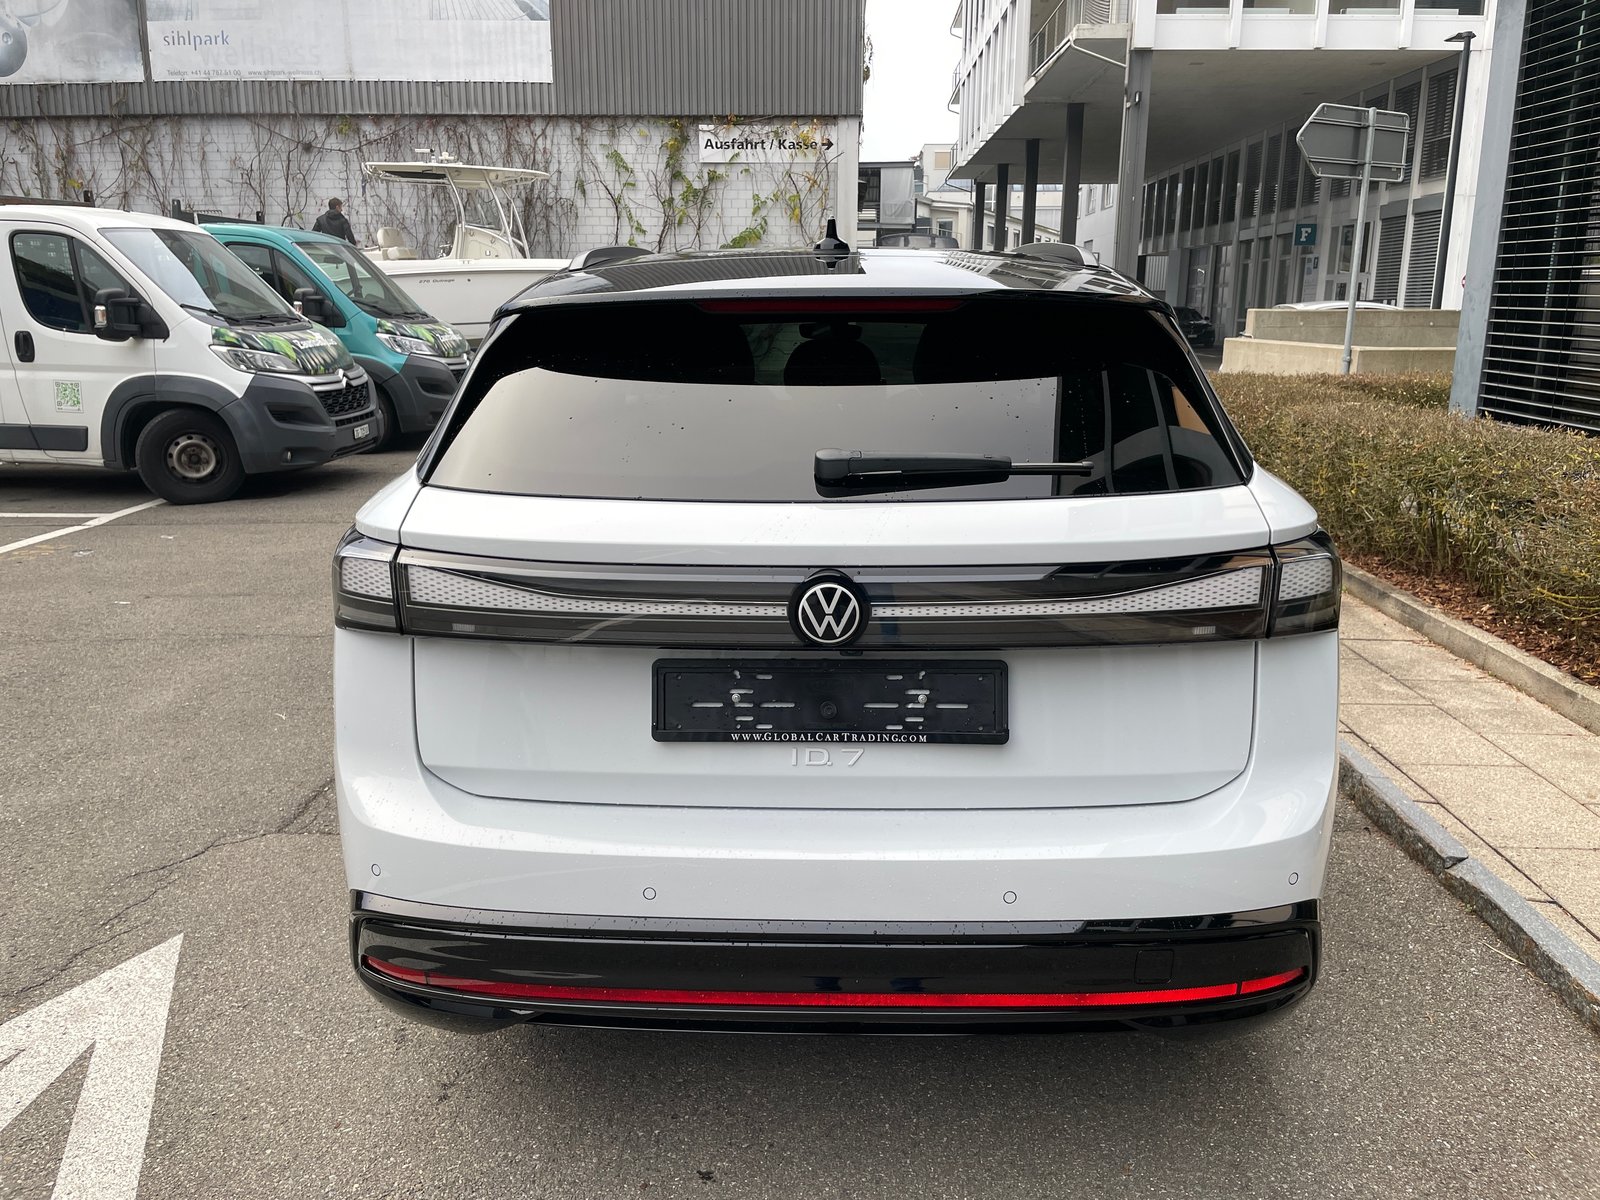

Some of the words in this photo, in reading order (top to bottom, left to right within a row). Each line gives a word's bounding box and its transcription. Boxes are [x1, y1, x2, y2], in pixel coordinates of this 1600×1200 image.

[163, 30, 229, 51] sihlpark
[704, 138, 766, 150] Ausfahrt
[769, 139, 775, 150] /
[778, 139, 818, 150] Kasse
[1300, 227, 1312, 241] F
[801, 585, 857, 640] VW
